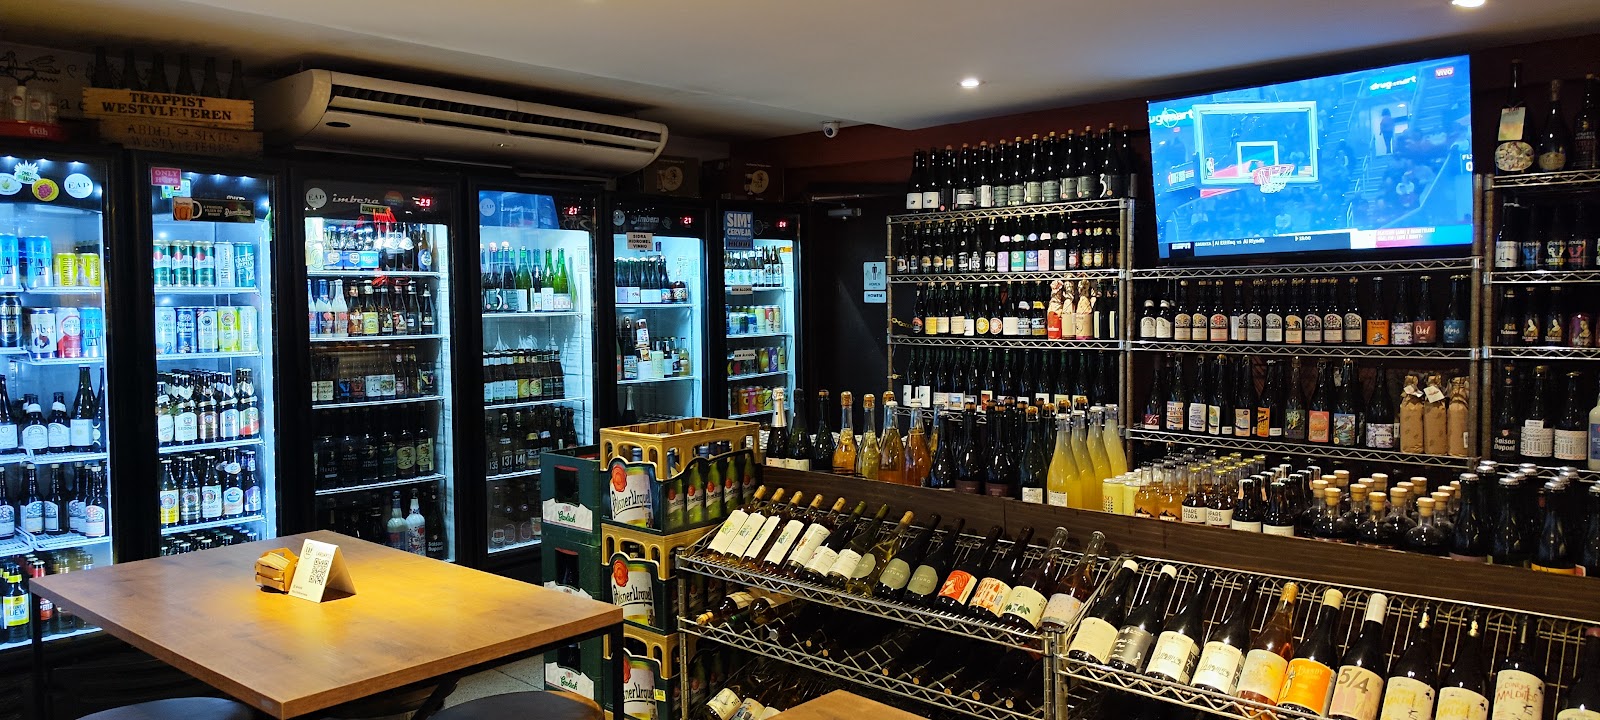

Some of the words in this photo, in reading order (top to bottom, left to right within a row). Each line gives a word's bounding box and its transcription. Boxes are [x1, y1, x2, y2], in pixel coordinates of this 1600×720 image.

[129, 92, 206, 108] TRAPPIST
[102, 102, 231, 121] WESTVLETEREN
[29, 126, 48, 136] früh
[726, 212, 752, 228] SIM!
[727, 227, 752, 237] CERVEJA
[1494, 437, 1516, 445] Saison
[1493, 443, 1516, 452] Dupont
[489, 461, 499, 470] 135
[501, 455, 513, 466] 137
[1337, 667, 1370, 695] 5/4
